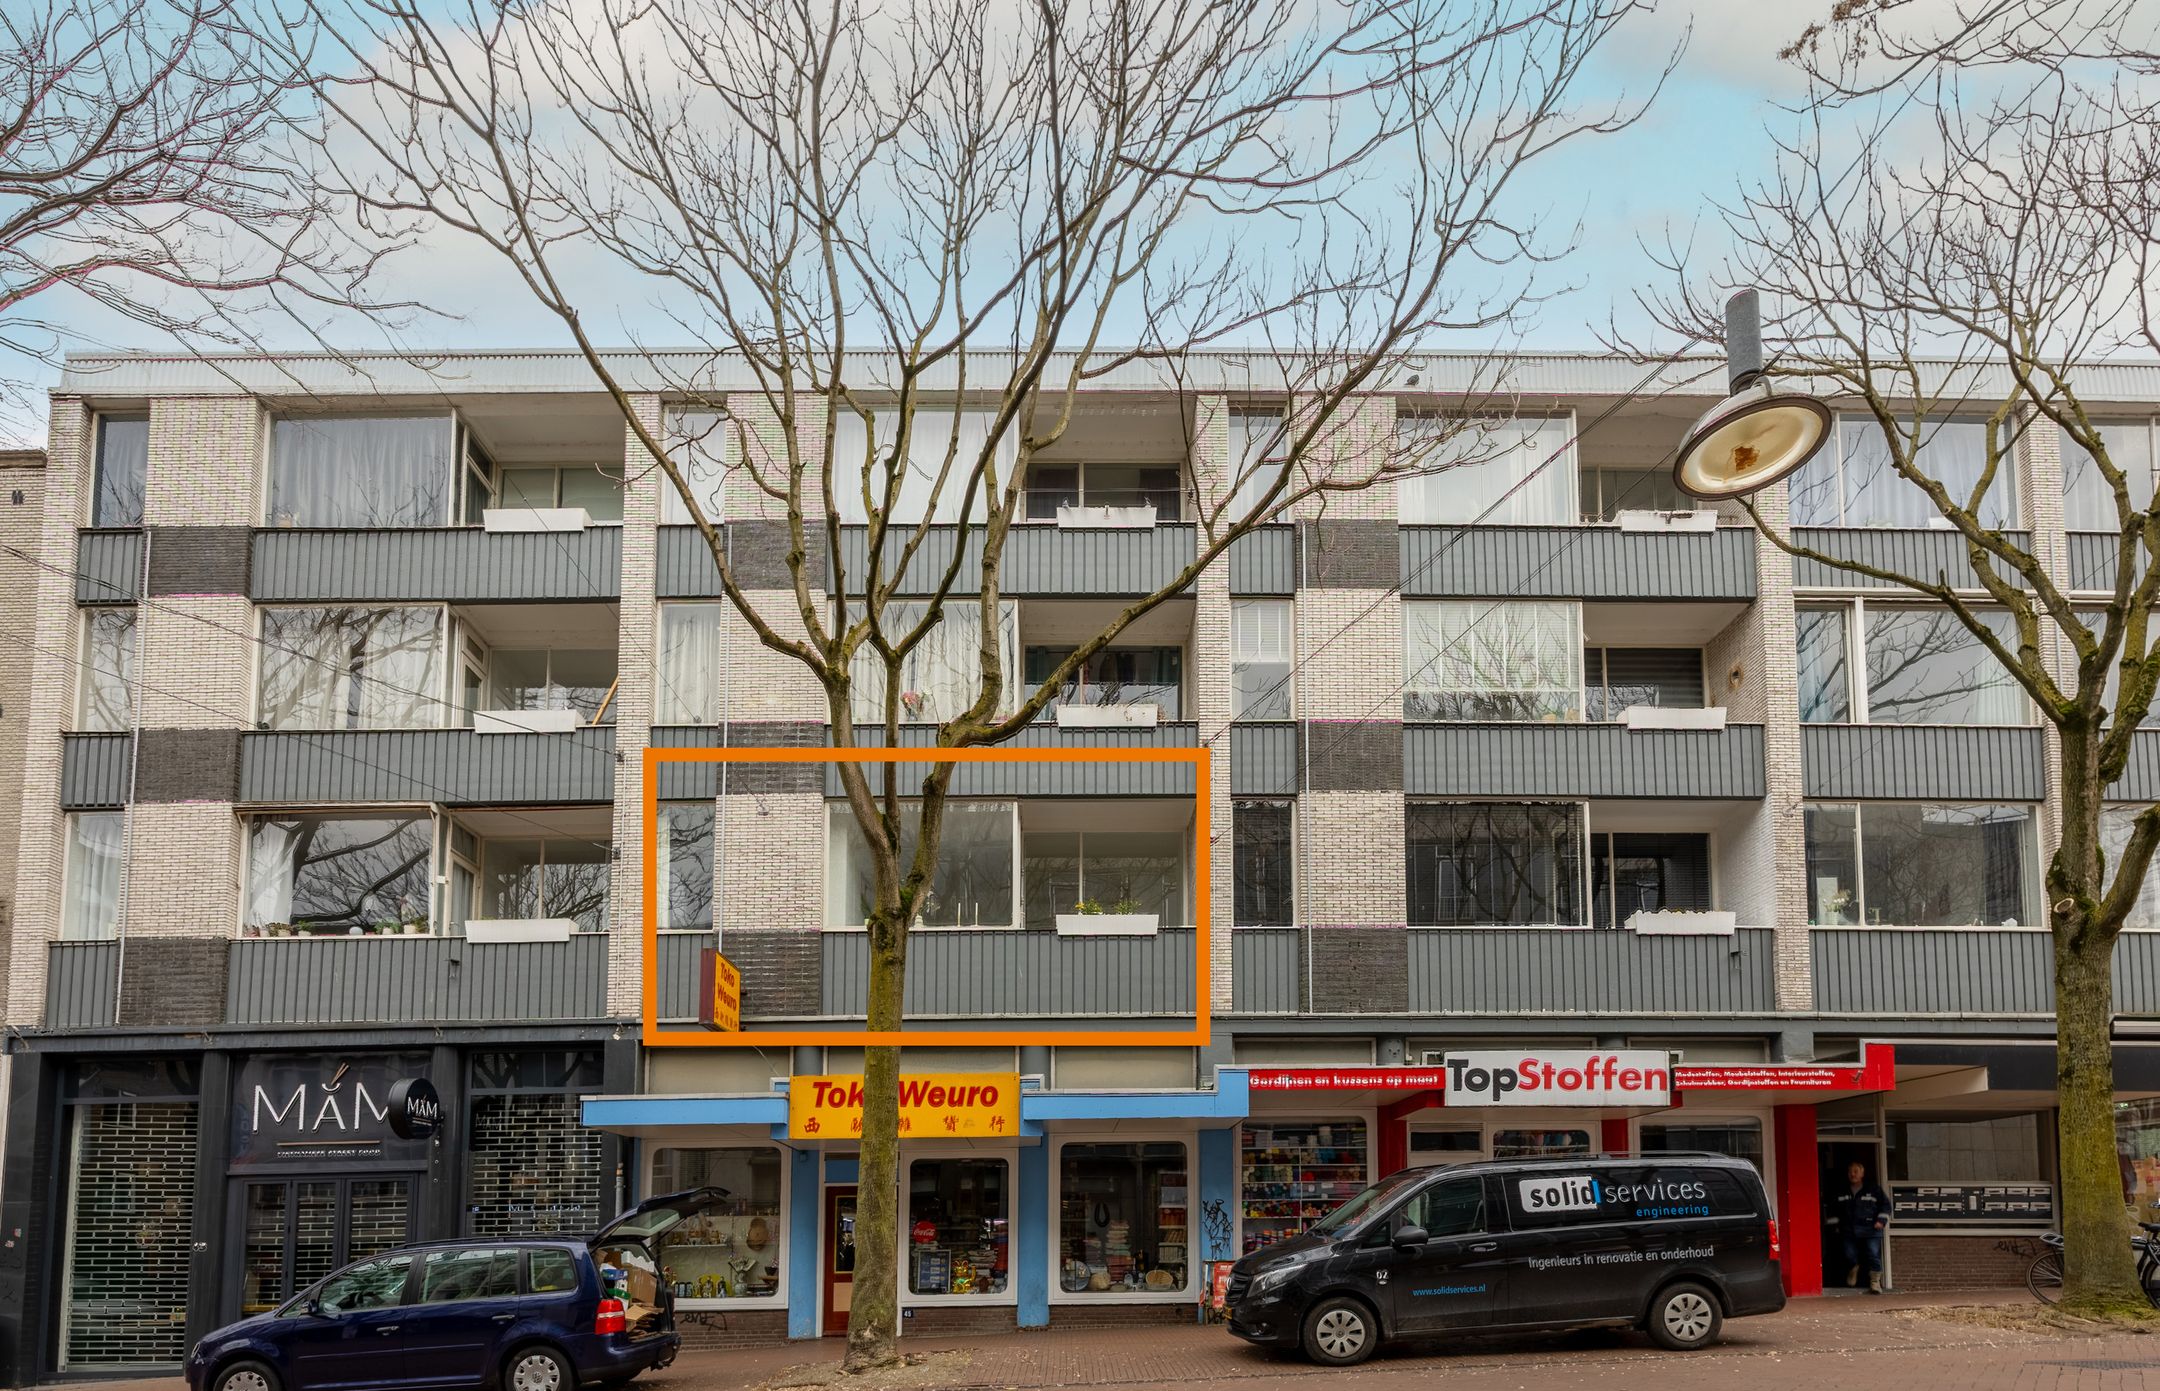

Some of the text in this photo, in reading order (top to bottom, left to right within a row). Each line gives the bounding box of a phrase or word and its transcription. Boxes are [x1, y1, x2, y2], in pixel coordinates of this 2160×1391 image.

[720, 962, 735, 988] Toko
[717, 982, 737, 1012] Weuro
[1249, 1073, 1438, 1089] Gordijnen en kussens op maat
[1447, 1056, 1667, 1102] TopStoffen
[812, 1080, 998, 1108] Tok Weuro
[1530, 1177, 1706, 1208] solid services
[1636, 1204, 1709, 1218] engineering
[1528, 1245, 1715, 1271] Ingenieurs in renovatie en onderhoud
[1412, 1284, 1486, 1296] www.solidservices.nl
